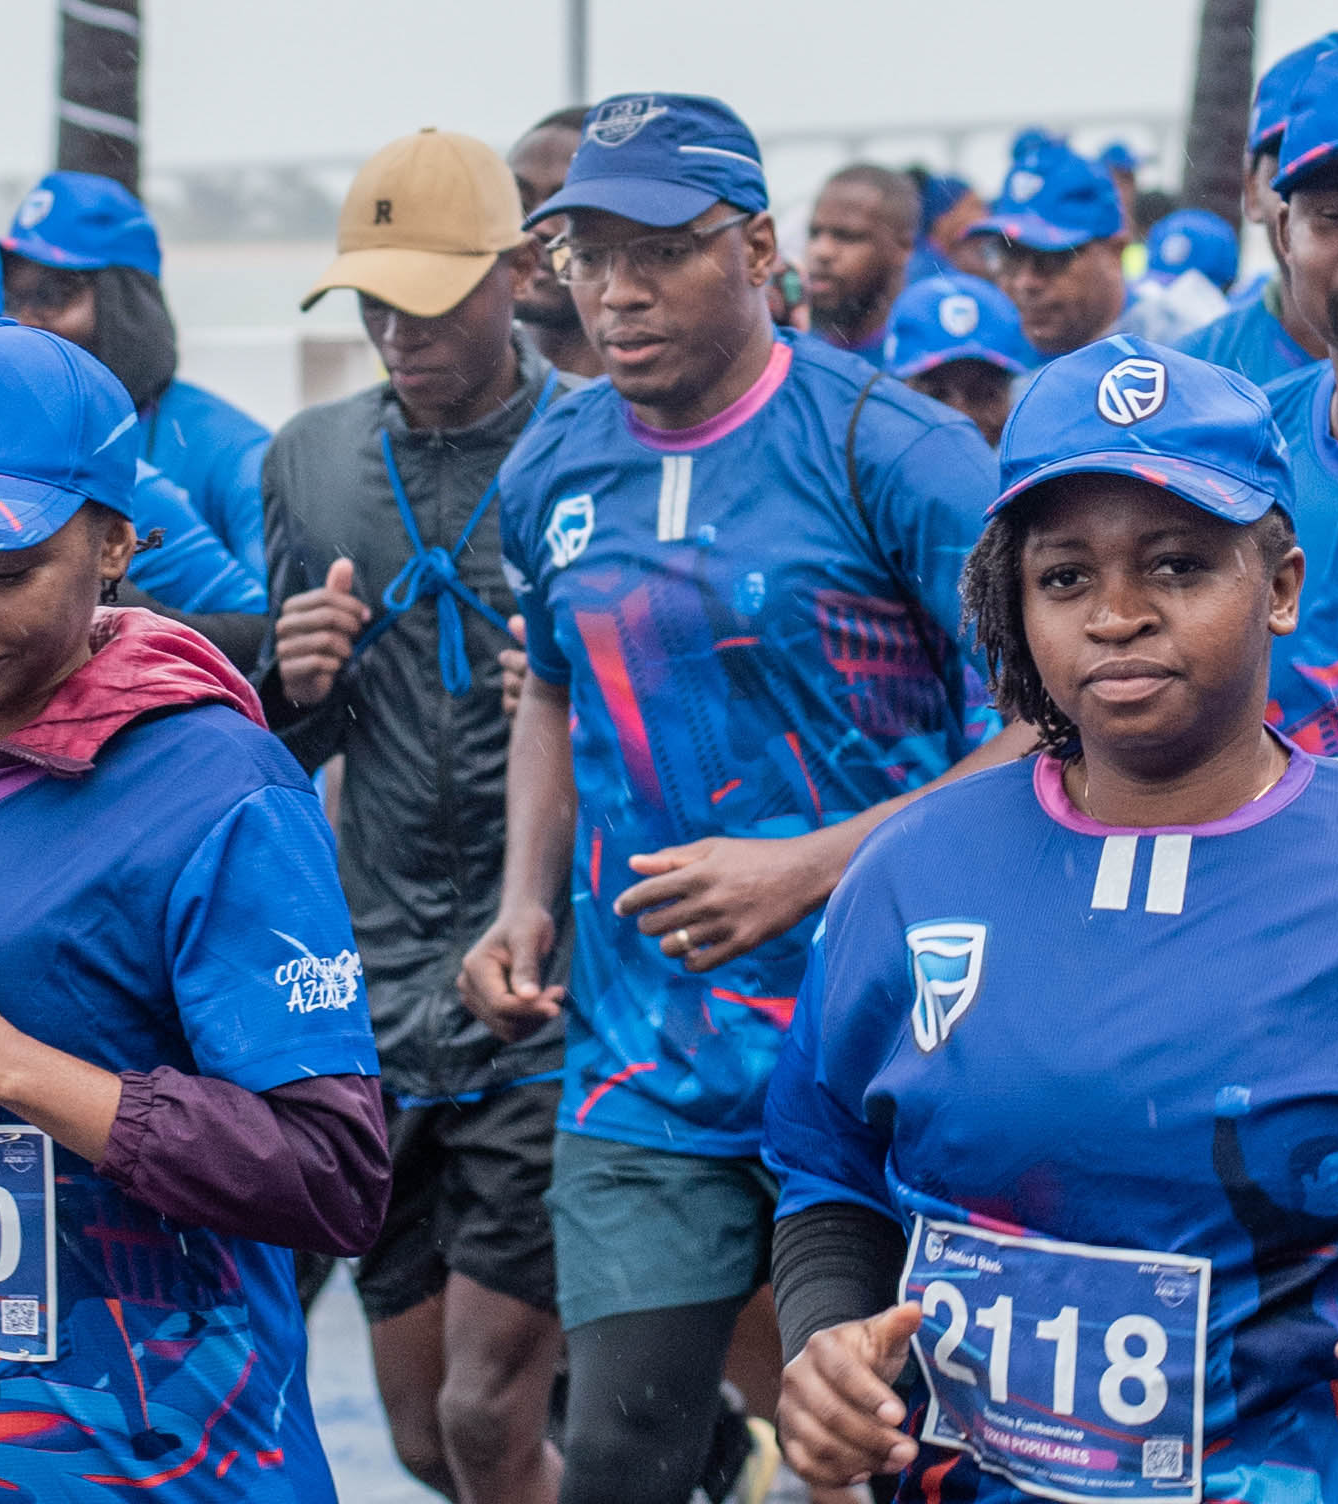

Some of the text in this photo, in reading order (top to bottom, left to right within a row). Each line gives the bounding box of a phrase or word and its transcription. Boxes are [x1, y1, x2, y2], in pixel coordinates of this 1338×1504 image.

[375, 200, 392, 225] R
[922, 1280, 1168, 1425] 2118
[1011, 1436, 1091, 1466] POPULARES
